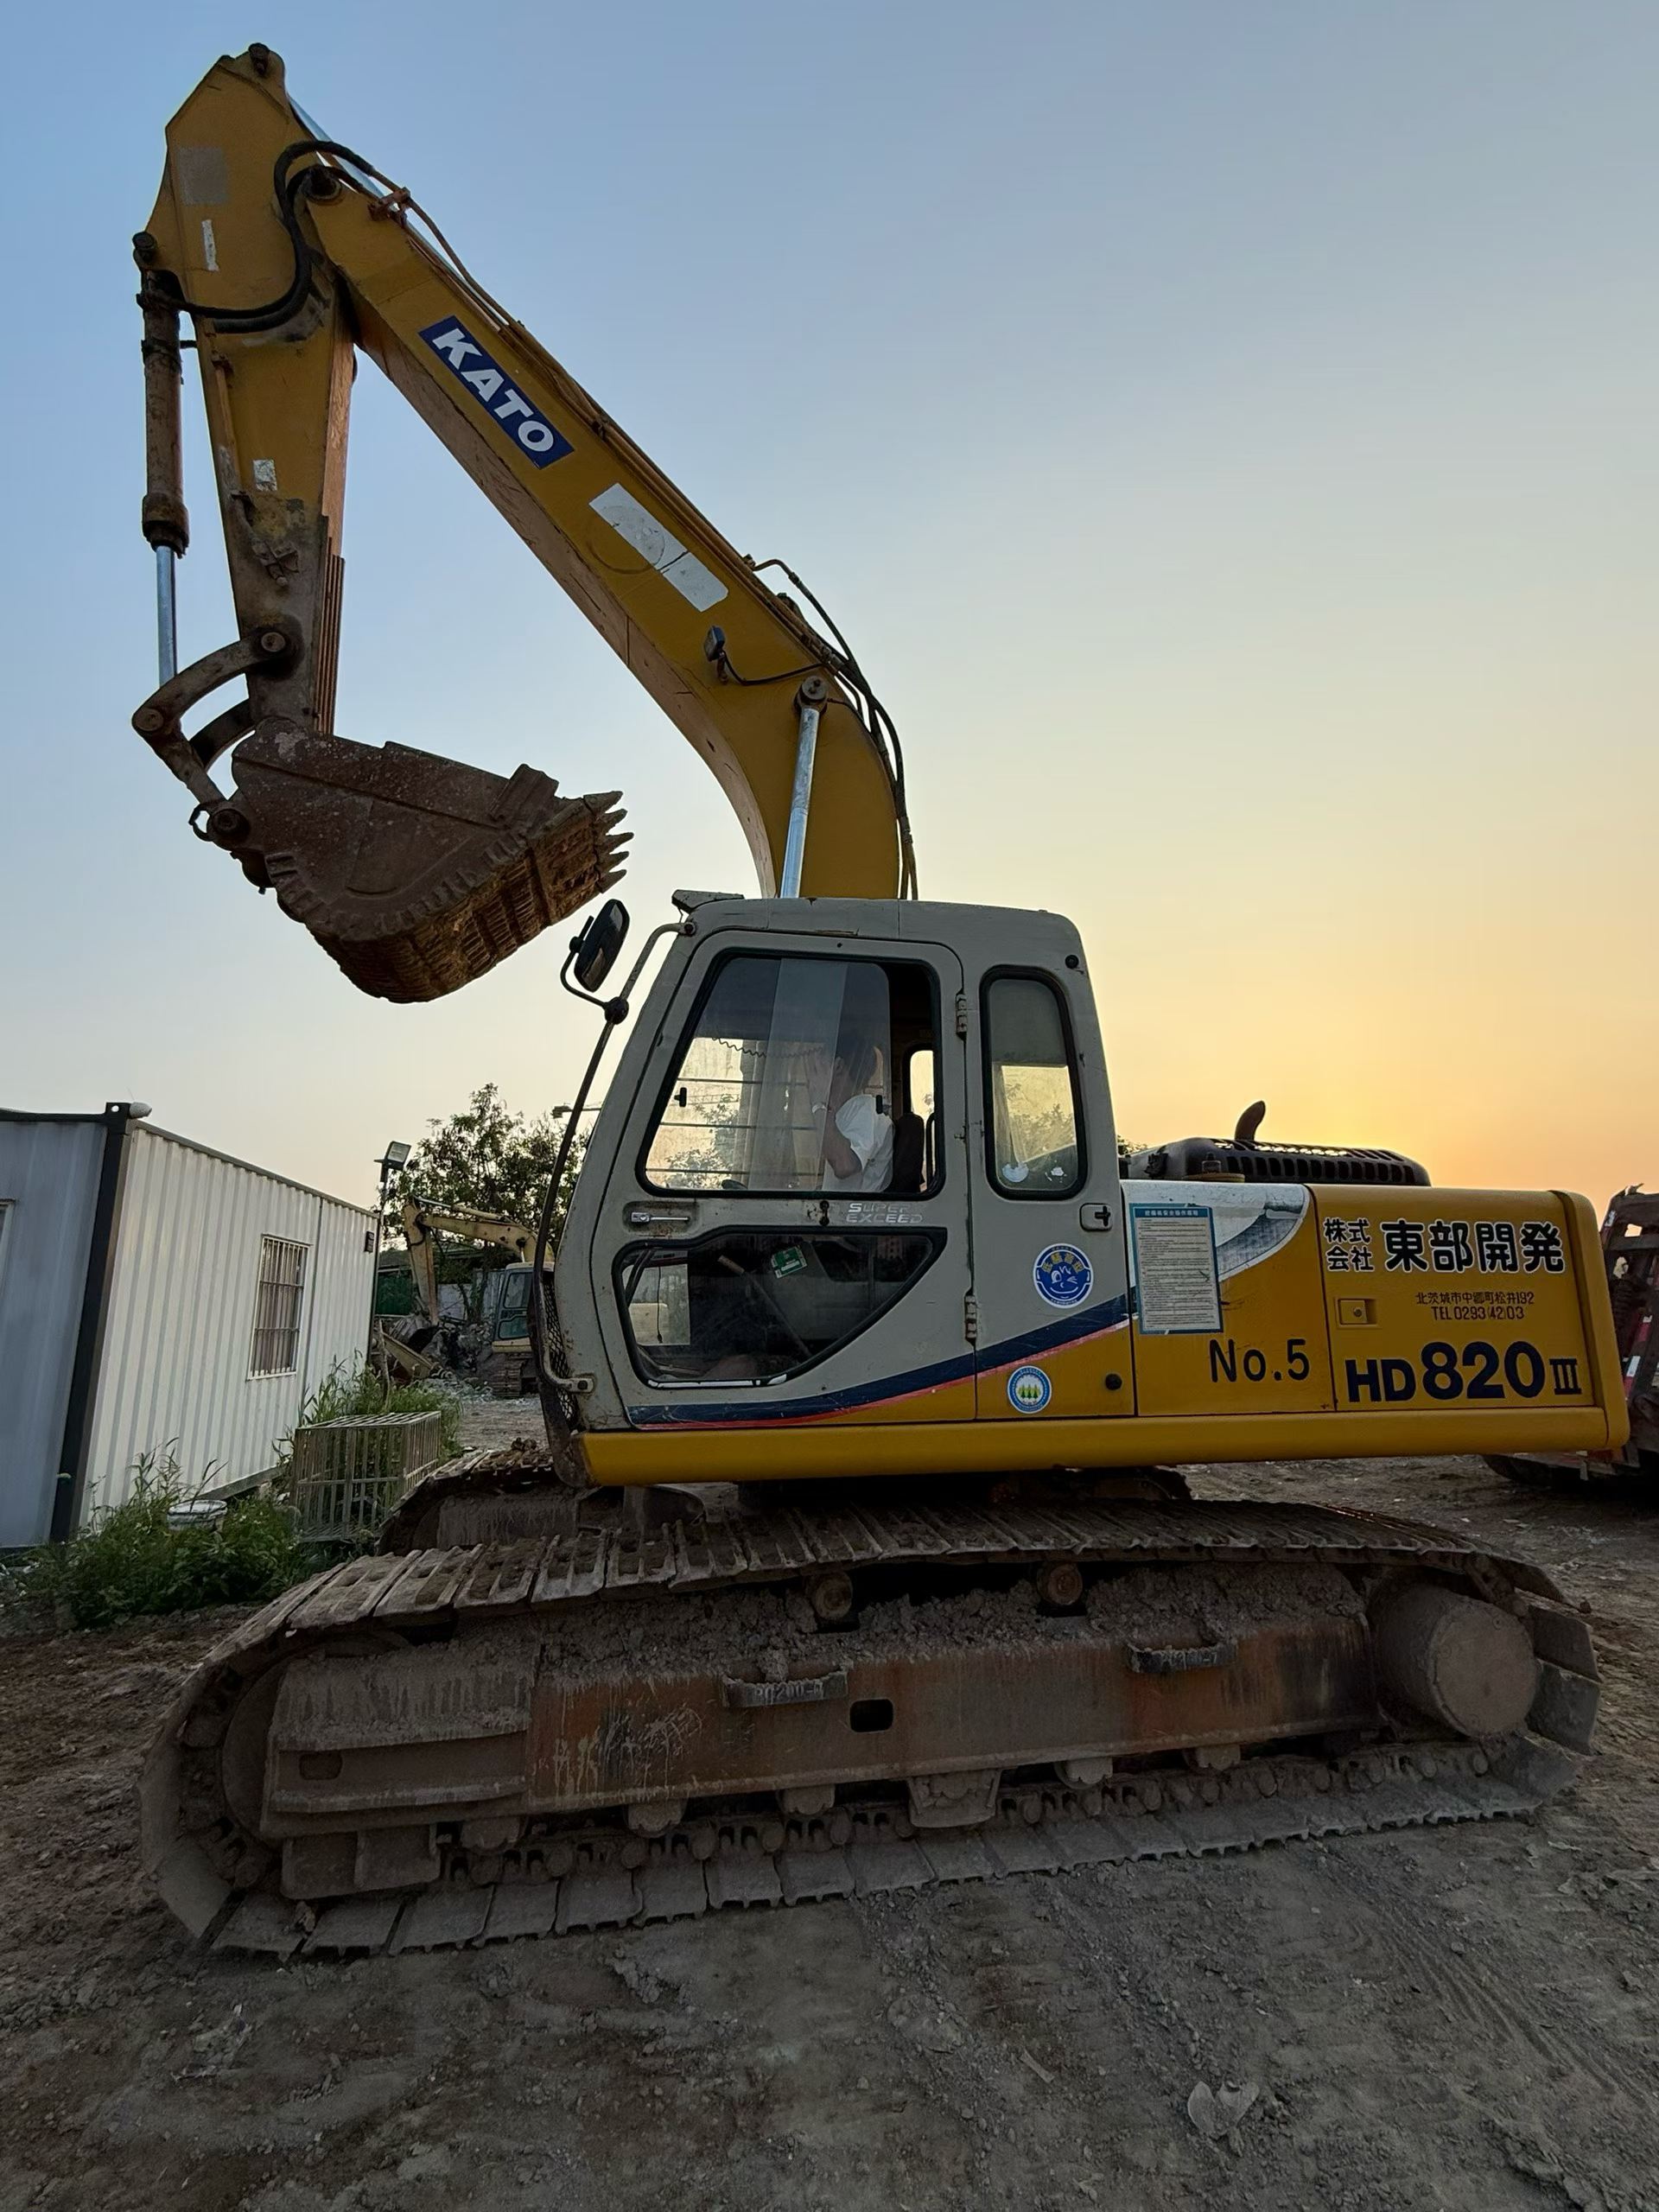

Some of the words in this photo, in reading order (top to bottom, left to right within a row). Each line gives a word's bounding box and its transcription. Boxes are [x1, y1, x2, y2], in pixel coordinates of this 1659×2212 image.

[432, 327, 554, 452] KATO
[846, 1213, 923, 1224] EXCEED
[848, 1203, 911, 1213] SUPER
[1380, 1217, 1566, 1274] 東部開発
[1210, 1338, 1310, 1382] No.5
